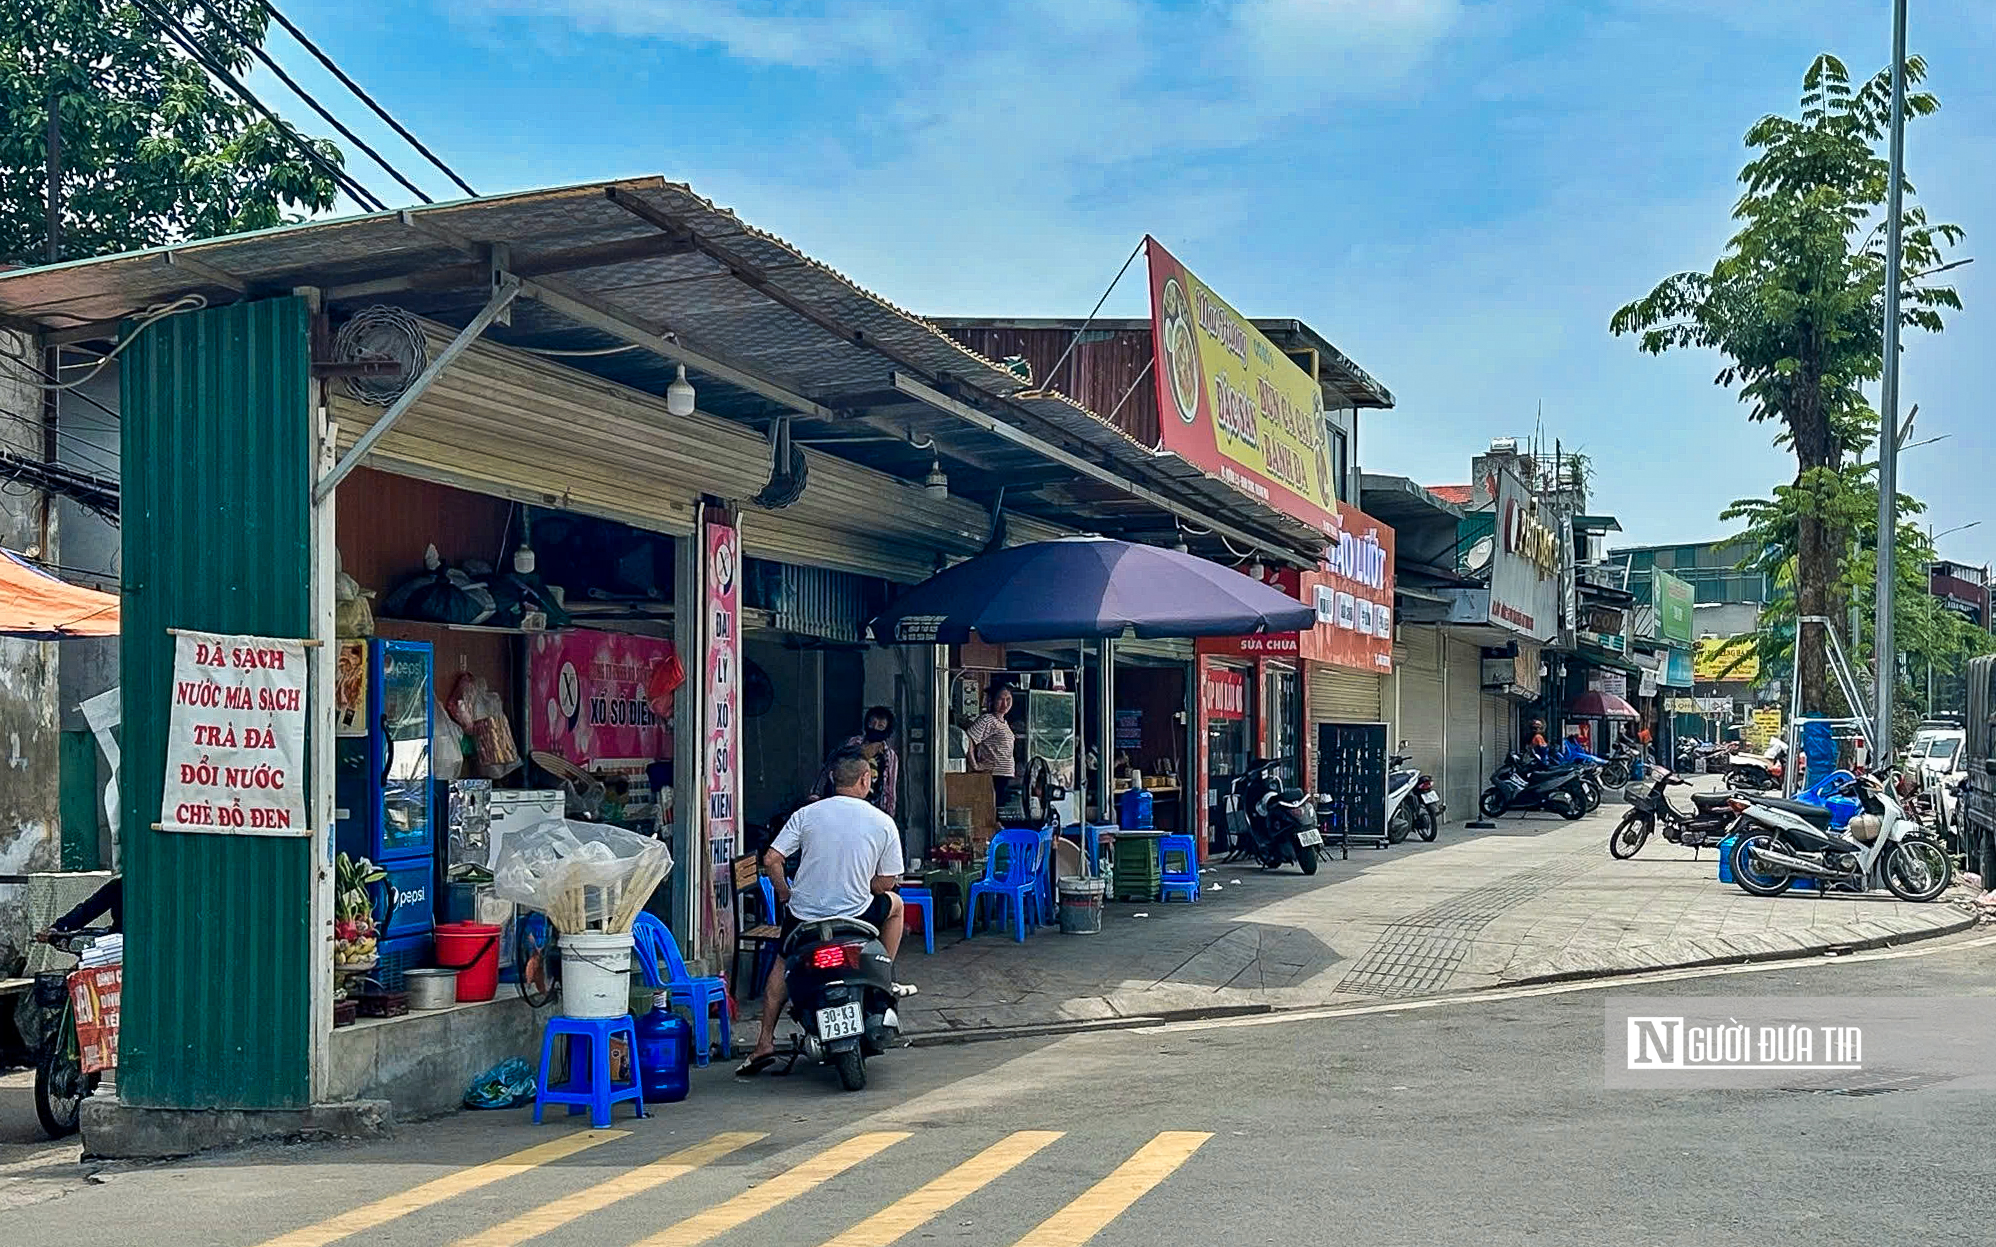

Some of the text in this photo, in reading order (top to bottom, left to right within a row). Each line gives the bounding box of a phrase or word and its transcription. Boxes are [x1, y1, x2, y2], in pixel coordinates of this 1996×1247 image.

[715, 611, 731, 643] ĐẠI
[195, 641, 285, 674] ĐÁ SẠCH
[717, 653, 728, 683] LÝ
[176, 678, 301, 717] NƯỚC MÍA SẠCH
[610, 688, 626, 726] SỐ
[194, 721, 276, 749] TRÀ ĐÁ
[180, 754, 285, 790] ĐỔI NƯỚC
[716, 739, 728, 773] SỐ
[176, 797, 291, 829] CHÈ ĐỖ ĐEN
[710, 785, 732, 819] KIẾN
[400, 886, 425, 908] pepsi
[823, 1005, 856, 1024] 30-K3
[825, 1020, 857, 1039] 7934
